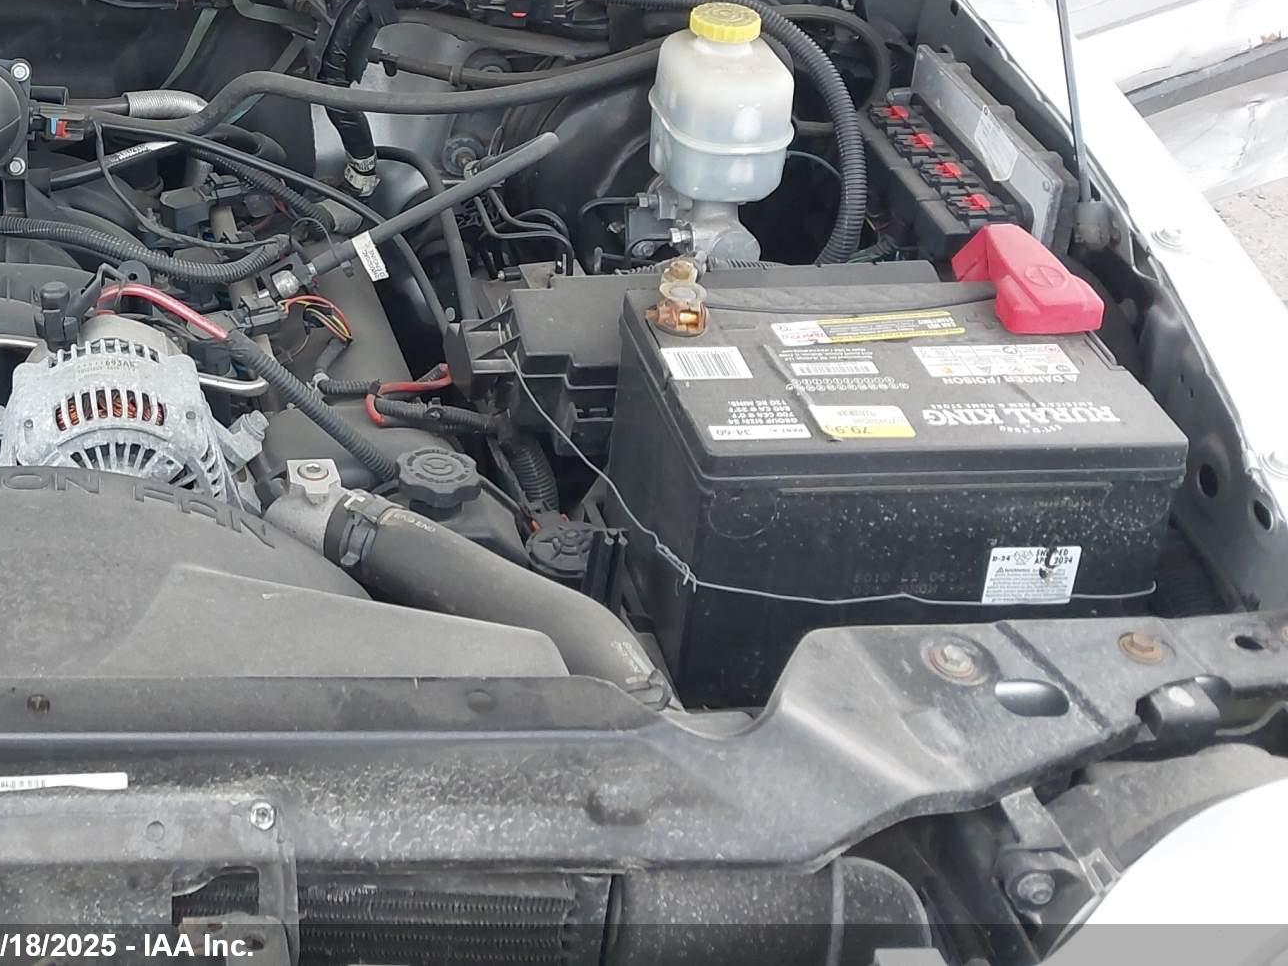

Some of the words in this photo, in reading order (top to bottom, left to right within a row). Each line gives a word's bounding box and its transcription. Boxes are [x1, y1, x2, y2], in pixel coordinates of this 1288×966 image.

[941, 376, 996, 385] POISON
[1002, 374, 1064, 383] DANGER
[922, 408, 1004, 426] KING
[1002, 405, 1121, 425] RURAL
[133, 474, 278, 549] FAN
[1036, 548, 1069, 556] SHED
